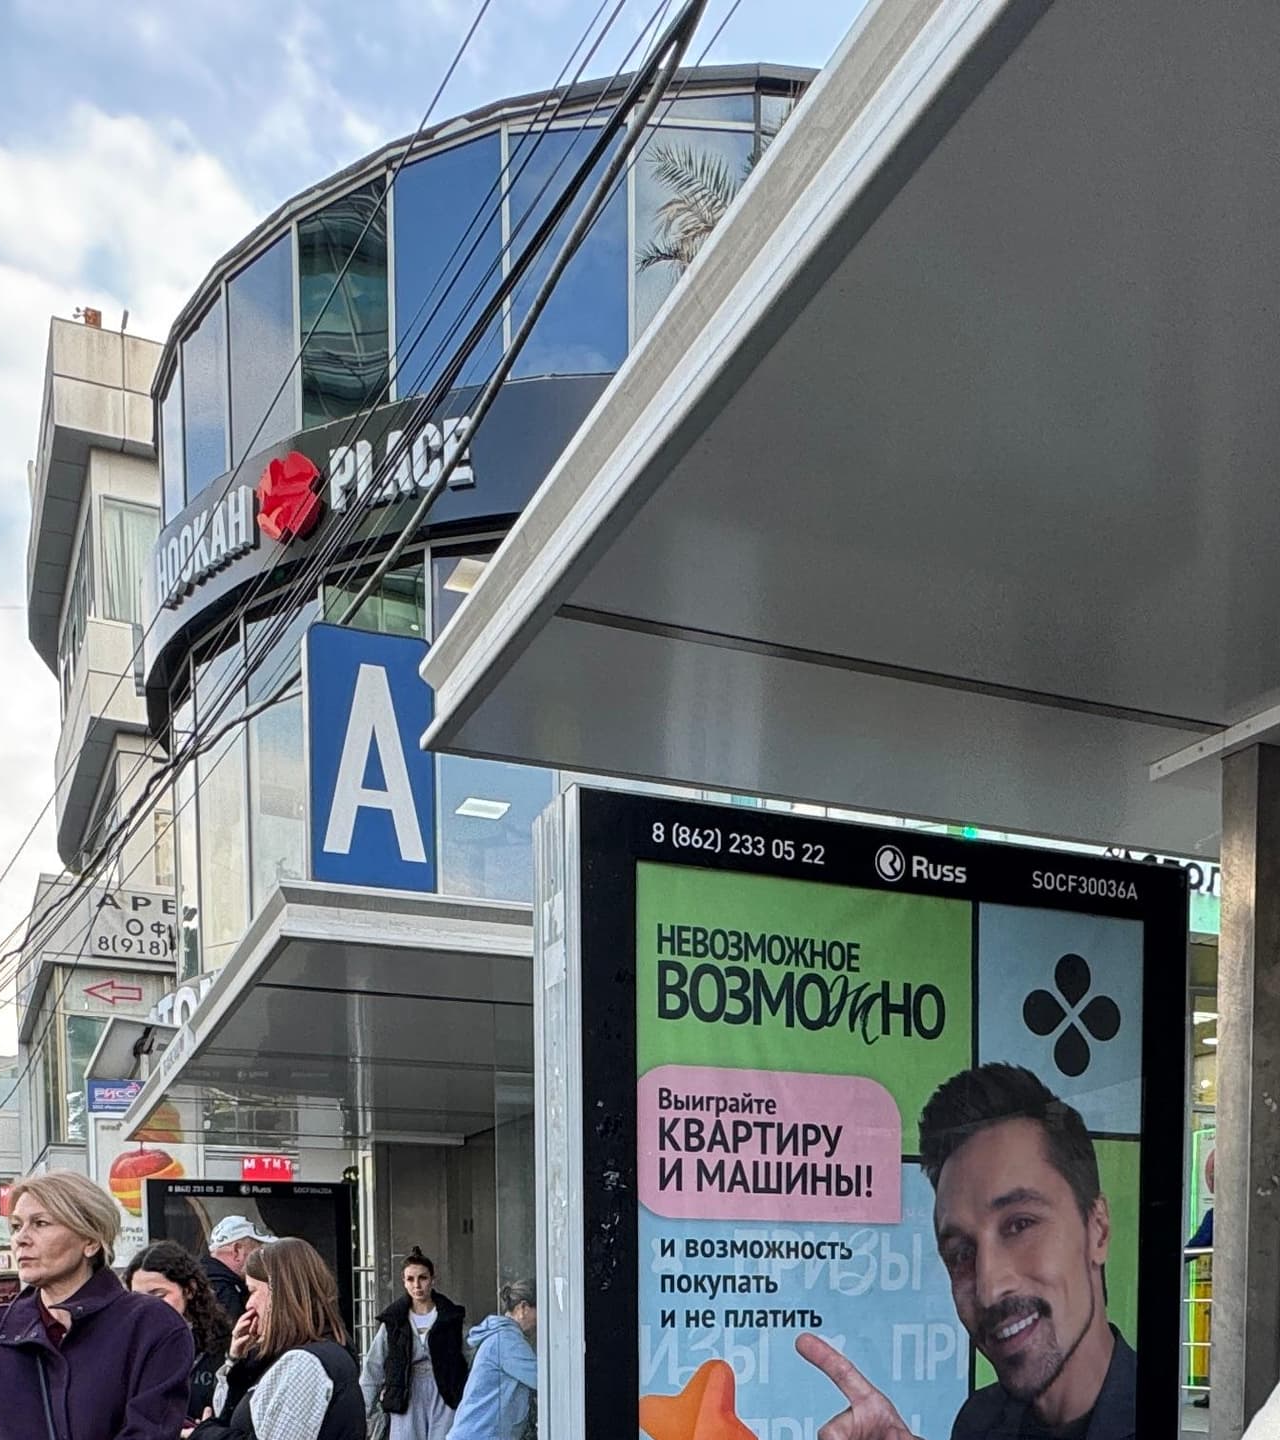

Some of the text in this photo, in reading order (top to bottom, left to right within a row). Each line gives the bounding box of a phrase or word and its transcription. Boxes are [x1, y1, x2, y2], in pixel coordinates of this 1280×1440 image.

[157, 416, 475, 604] HOOKAH PLACE
[652, 822, 826, 866] 8 (862) 233 05 22
[911, 857, 967, 884] Russ
[97, 934, 168, 958] 8(918)
[656, 923, 861, 973] НЕВОЗМОЖНОЕ
[656, 960, 946, 1045] ВОЗМОЖНО
[657, 1086, 778, 1118] Выиграйте
[657, 1117, 844, 1157] КВАРТИРУ
[657, 1158, 873, 1198] И МАШИНЫ!
[659, 1238, 853, 1261] и возможность
[659, 1273, 779, 1300] покупать
[660, 1309, 823, 1329] и не платить
